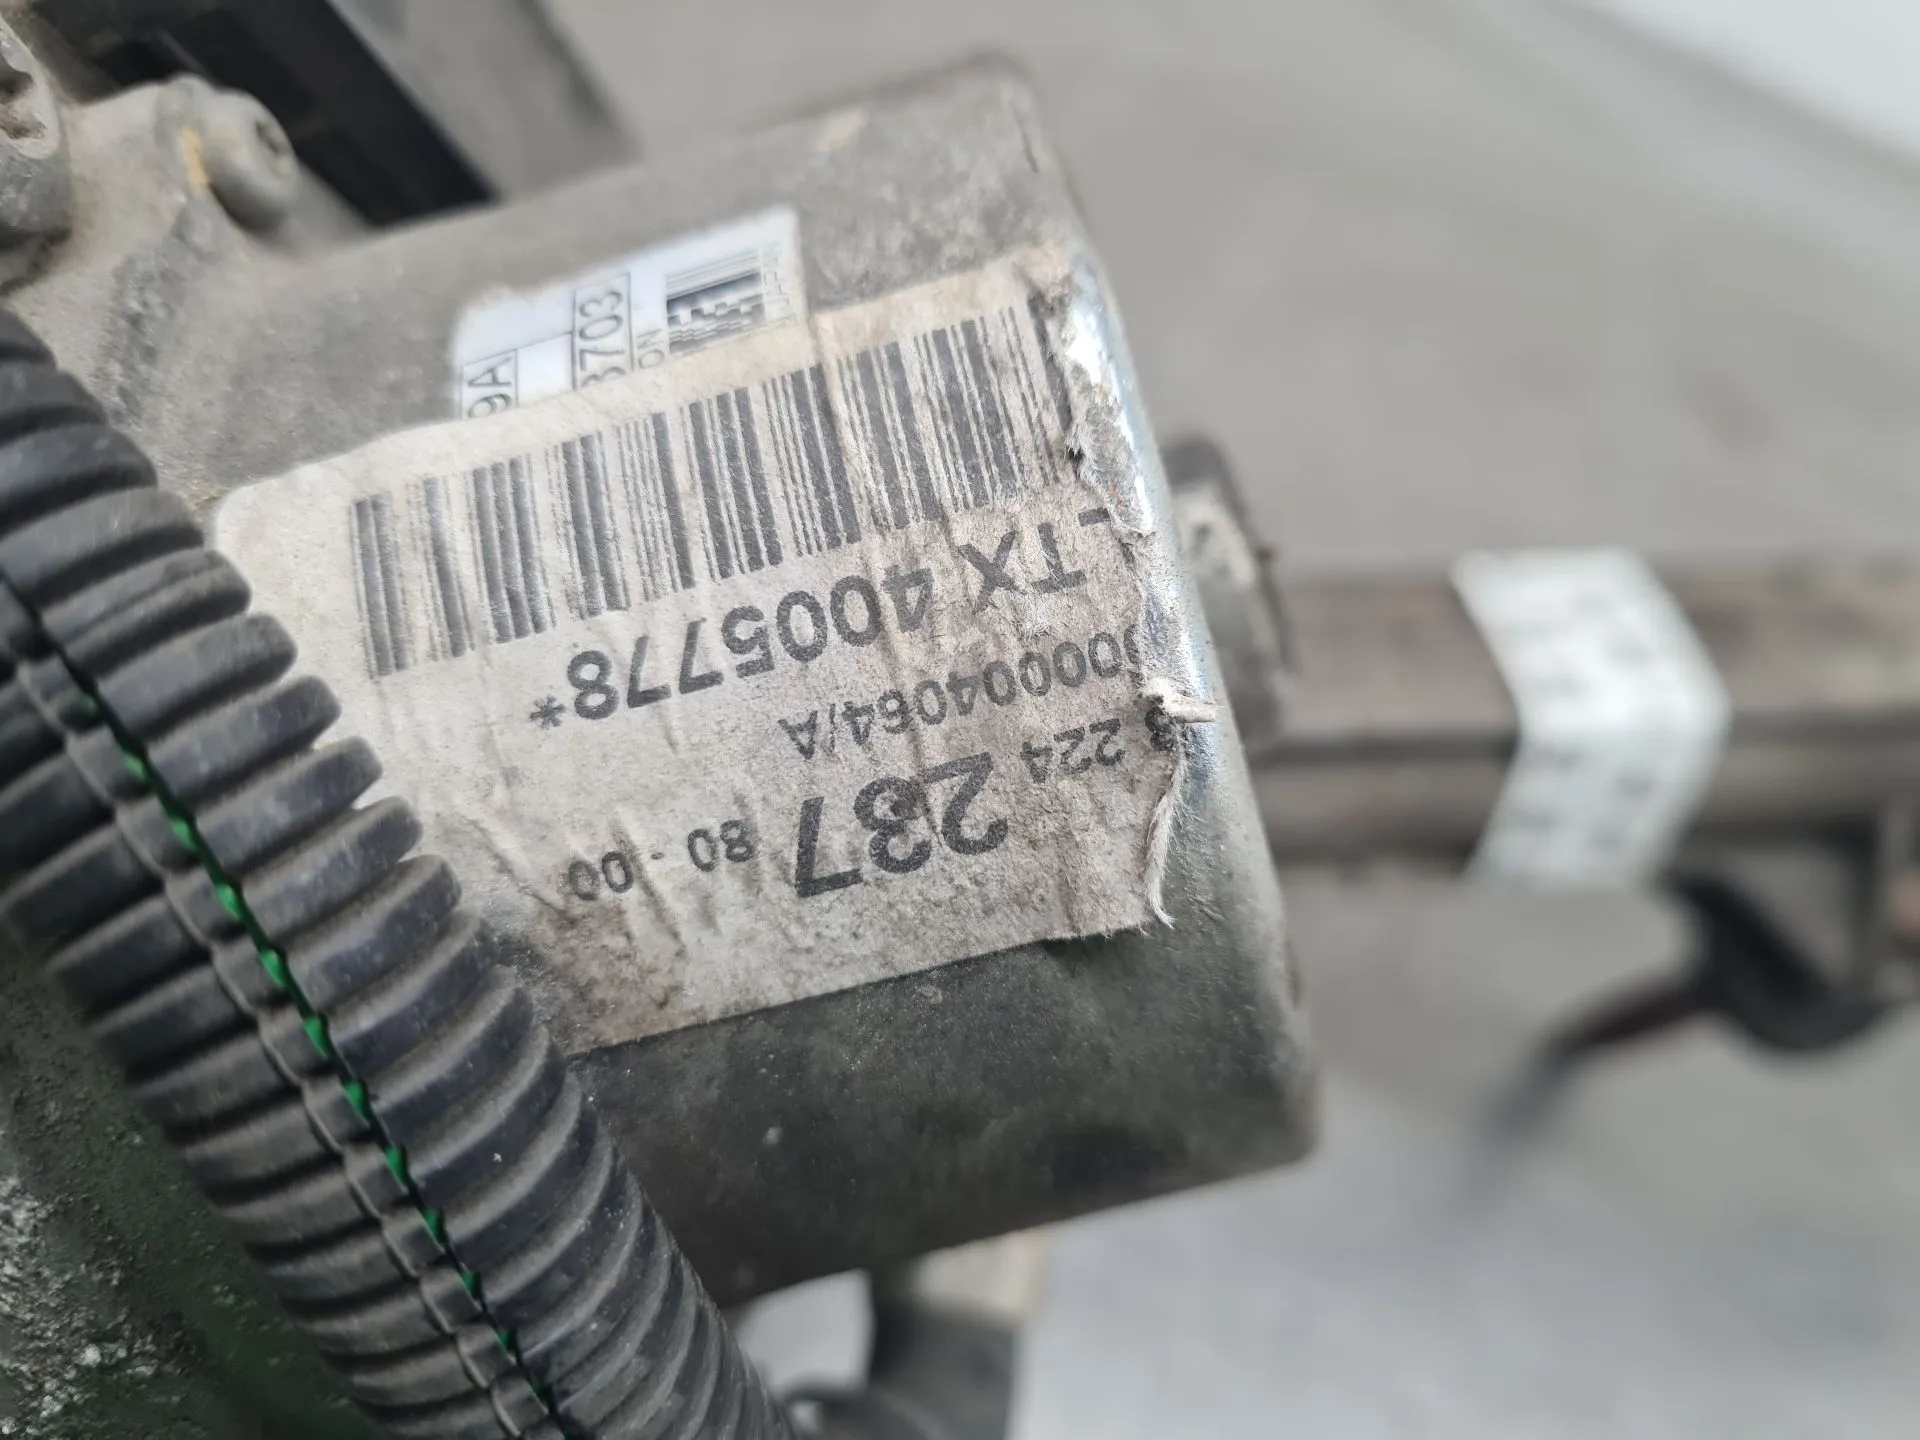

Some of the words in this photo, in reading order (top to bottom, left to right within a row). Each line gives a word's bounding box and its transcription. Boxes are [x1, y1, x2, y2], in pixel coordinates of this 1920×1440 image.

[467, 355, 514, 419] 9A
[1019, 717, 1126, 784] 224
[687, 818, 752, 873] 80
[795, 751, 1009, 898] 237
[567, 850, 634, 901] 00
